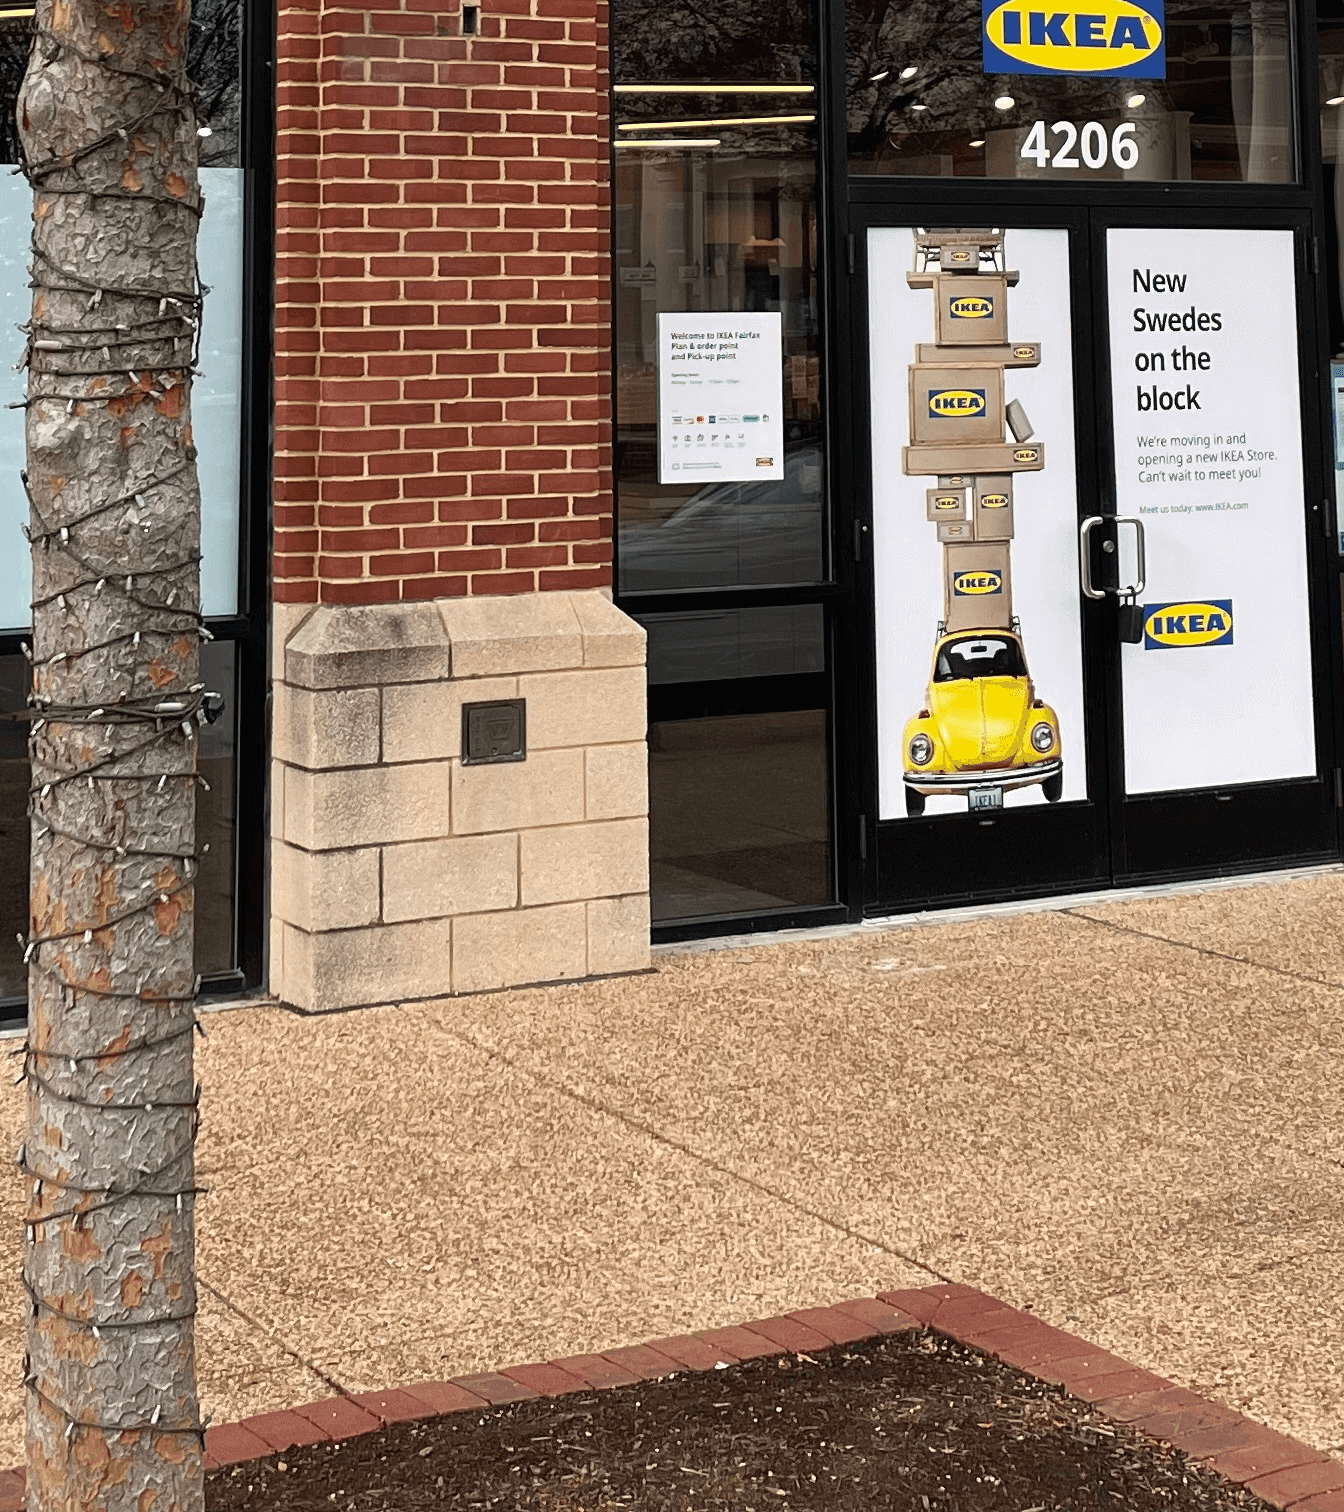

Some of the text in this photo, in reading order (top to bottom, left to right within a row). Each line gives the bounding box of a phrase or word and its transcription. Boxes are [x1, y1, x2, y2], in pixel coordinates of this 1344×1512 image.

[1002, 11, 1151, 50] IKEA
[1020, 120, 1140, 170] 4206
[1133, 269, 1188, 293] New
[955, 303, 990, 312] IKEA
[1134, 307, 1223, 332] Swedes
[1135, 347, 1211, 371] on the
[935, 397, 981, 409] IKEA
[1137, 385, 1201, 412] block
[1137, 432, 1246, 449] We're moving in and
[1138, 449, 1278, 468] opening a new IKEA Store.
[1138, 467, 1262, 483] Can't wait to meet you!
[1139, 505, 1159, 514] Meet
[1160, 506, 1169, 514] us
[1195, 502, 1249, 512] www.IKEA.com
[959, 577, 998, 589] IKEA
[1154, 614, 1227, 634] IKEA
